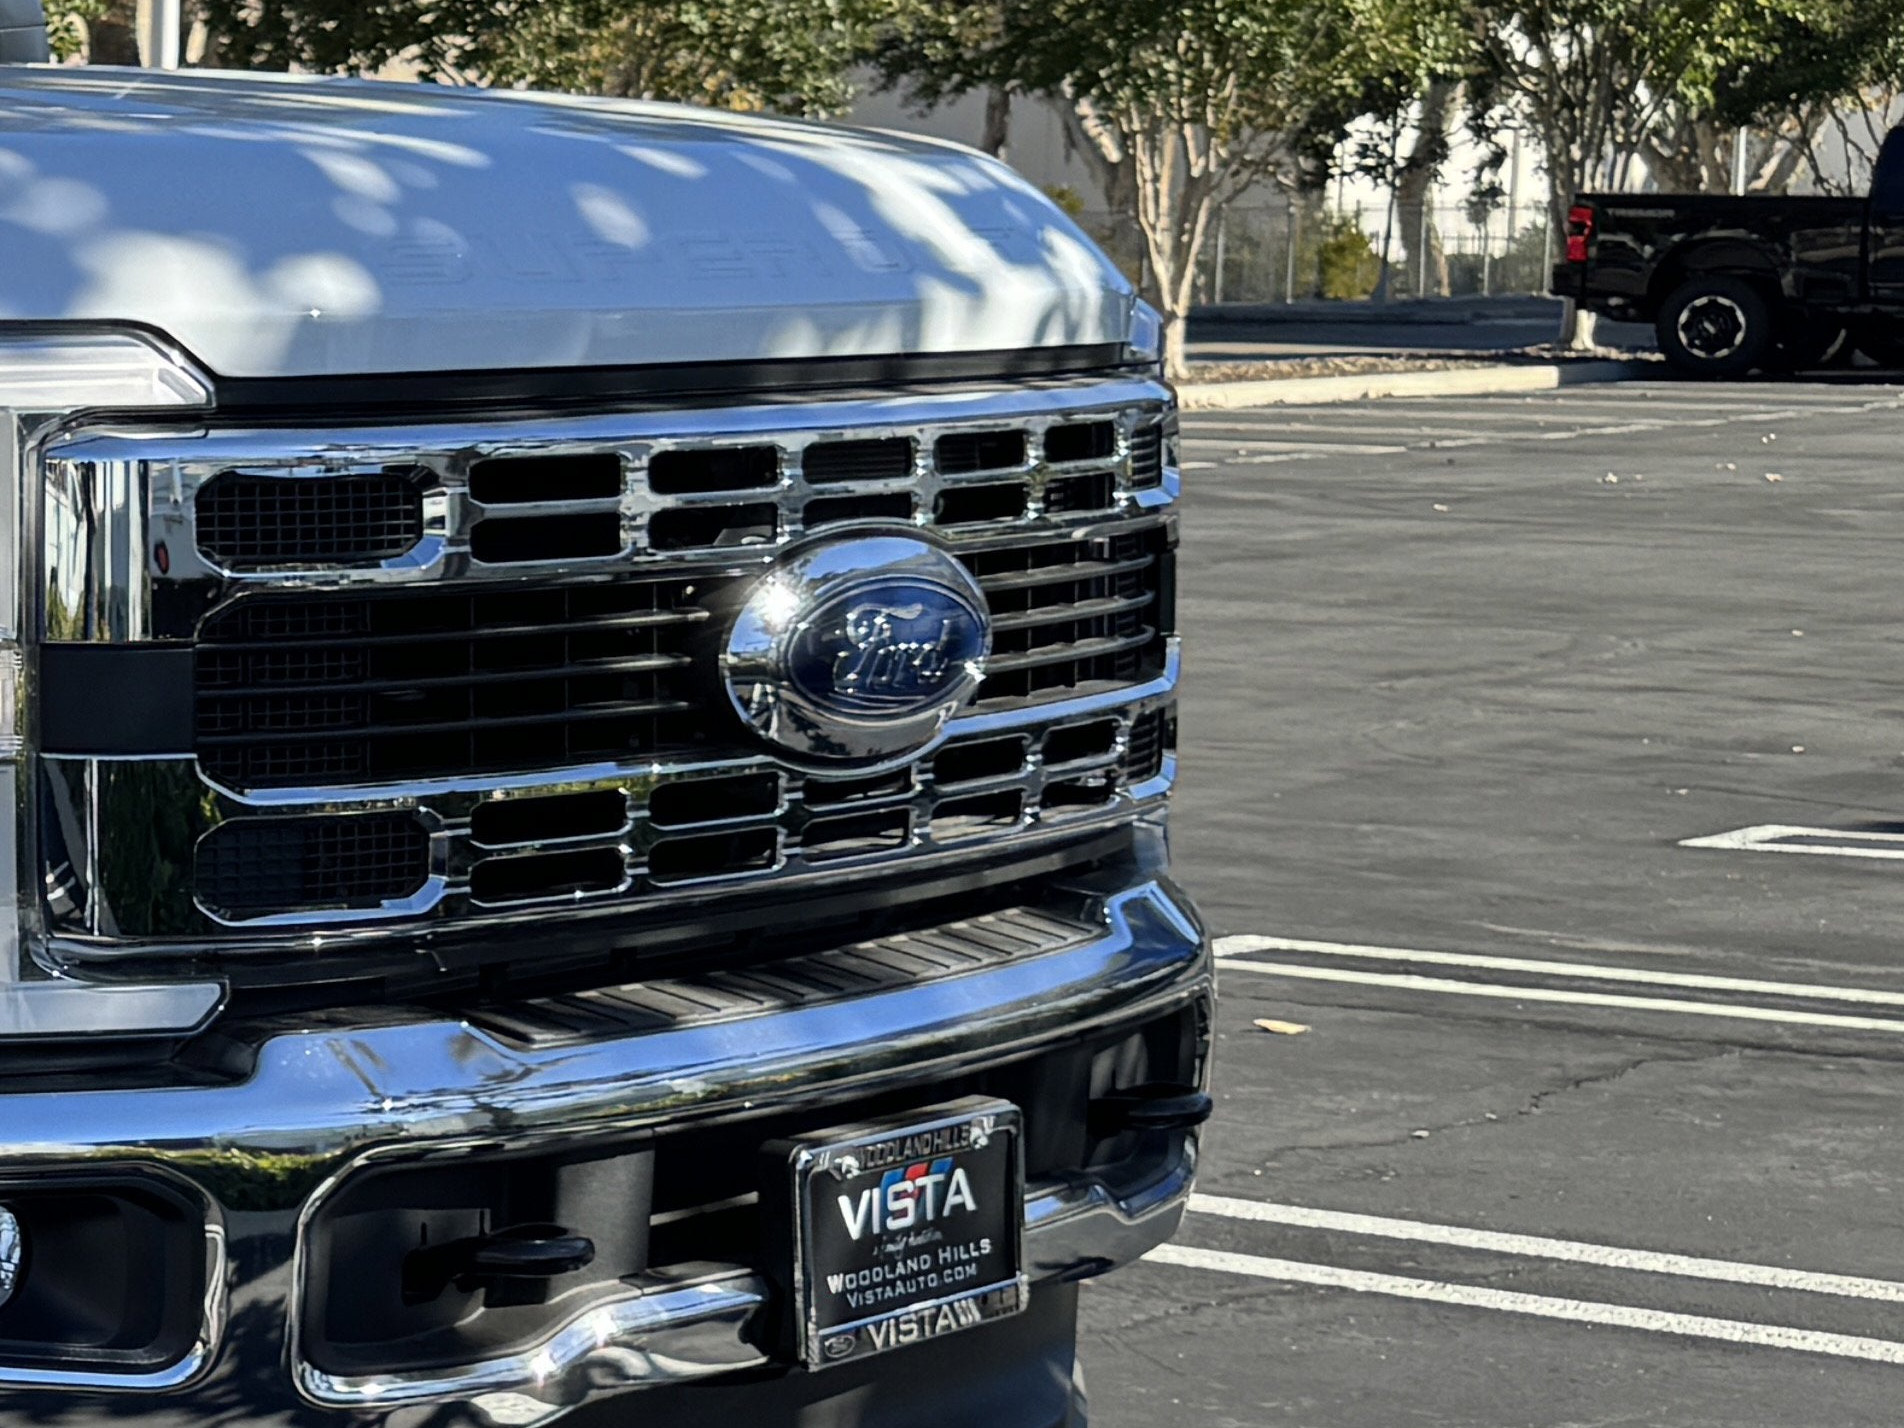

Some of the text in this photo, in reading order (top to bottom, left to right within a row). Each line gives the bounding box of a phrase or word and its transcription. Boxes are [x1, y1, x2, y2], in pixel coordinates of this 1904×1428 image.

[833, 602, 950, 695] Ford
[837, 1167, 978, 1241] VISTA
[827, 1254, 932, 1295] WOODLAND
[938, 1238, 992, 1265] HILLS
[846, 1262, 978, 1309] VISTAAUTO.COM
[867, 1303, 958, 1352] VISTA
